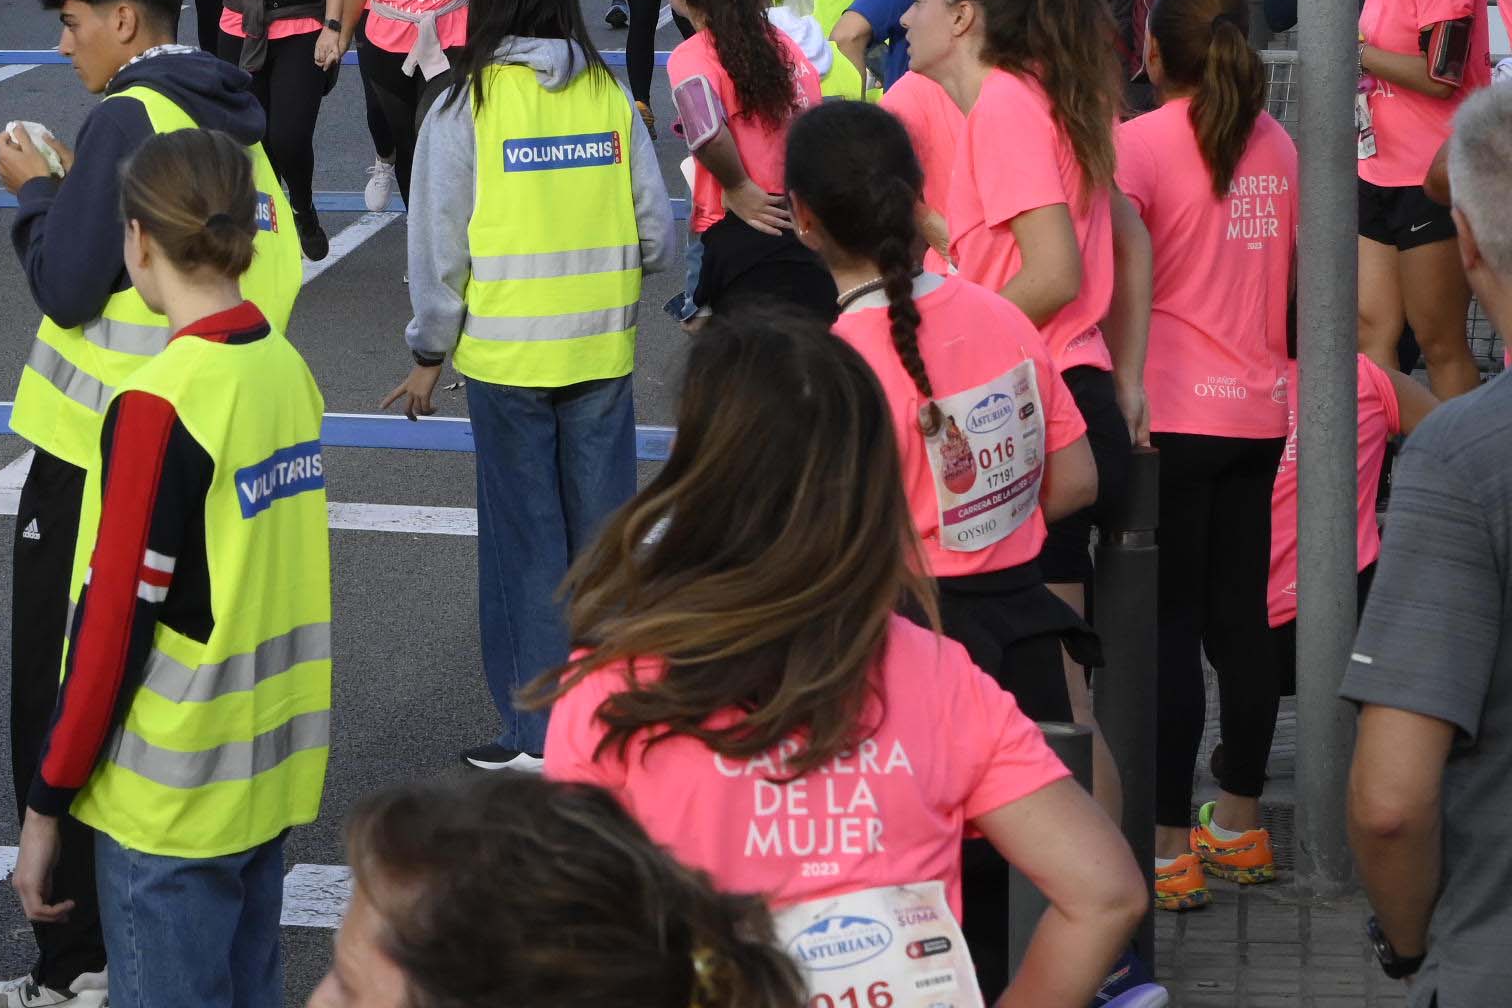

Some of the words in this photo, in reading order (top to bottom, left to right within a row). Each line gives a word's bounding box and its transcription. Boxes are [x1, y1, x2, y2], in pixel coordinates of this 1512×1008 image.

[506, 141, 613, 164] VOLUNTARIS
[1224, 175, 1289, 198] ARRERA
[1231, 198, 1251, 219] DE
[1256, 197, 1275, 217] LA
[1227, 219, 1278, 240] MUJER
[1194, 383, 1246, 399] OYSHO
[971, 404, 1012, 429] ASTURIANA
[979, 436, 1015, 470] 016
[987, 466, 1015, 489] 17191
[958, 497, 991, 519] CARRERA
[992, 494, 1002, 506] DE
[957, 518, 997, 542] OYSHO
[713, 738, 914, 777] CARERA
[754, 778, 809, 817] DE
[826, 777, 879, 814] LA
[744, 817, 886, 857] MUJER
[801, 861, 839, 878] 2023
[897, 912, 938, 928] SUMA
[795, 933, 887, 962] ASTURIANA
